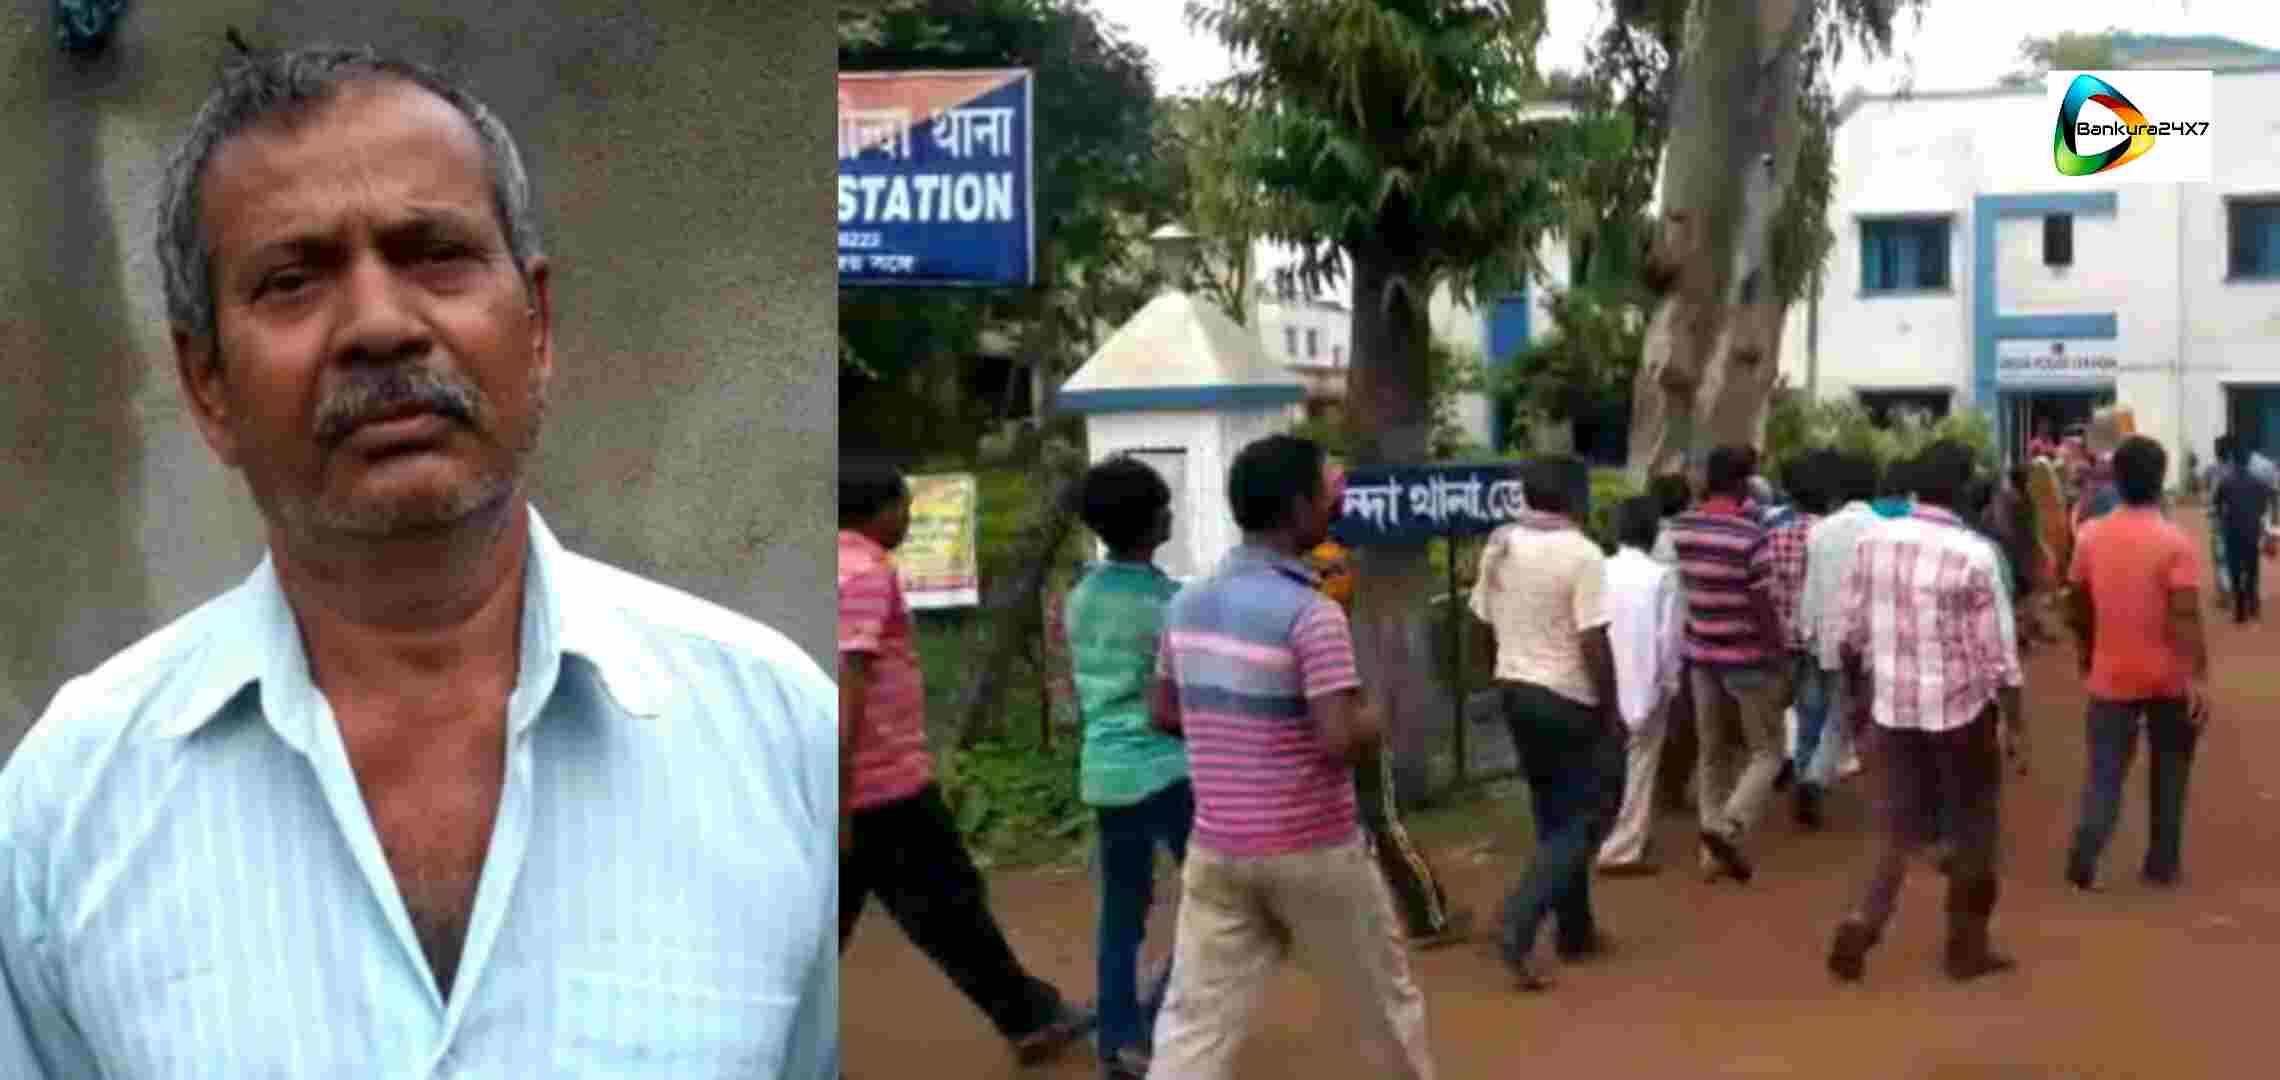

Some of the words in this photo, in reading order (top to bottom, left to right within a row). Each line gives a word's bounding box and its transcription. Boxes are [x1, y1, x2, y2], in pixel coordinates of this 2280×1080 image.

[931, 106, 1014, 159] থানা
[838, 173, 1013, 222] STATION
[1343, 474, 1403, 533] ন্দা
